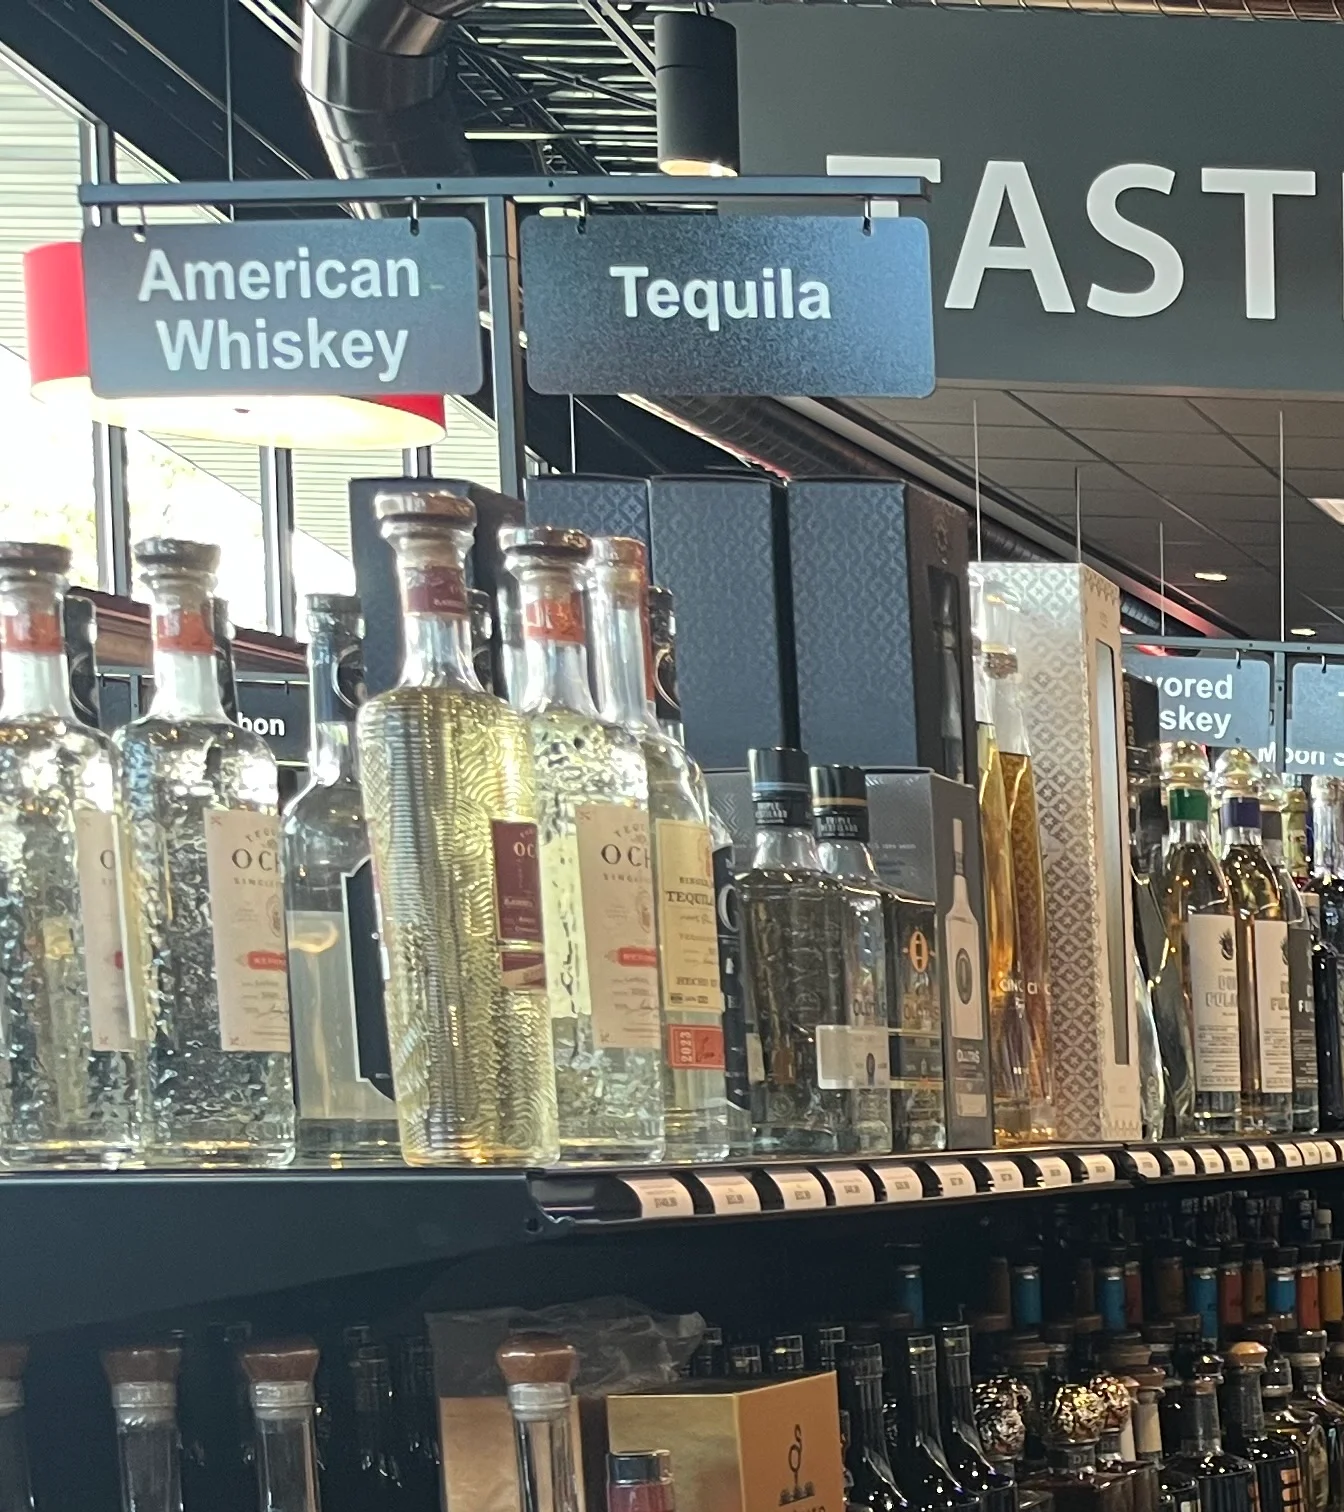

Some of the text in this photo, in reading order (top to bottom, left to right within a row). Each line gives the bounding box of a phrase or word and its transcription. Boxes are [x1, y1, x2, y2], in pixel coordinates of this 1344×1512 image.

[138, 247, 421, 304] American
[609, 266, 832, 331] Tequila
[155, 319, 410, 382] Whiskey
